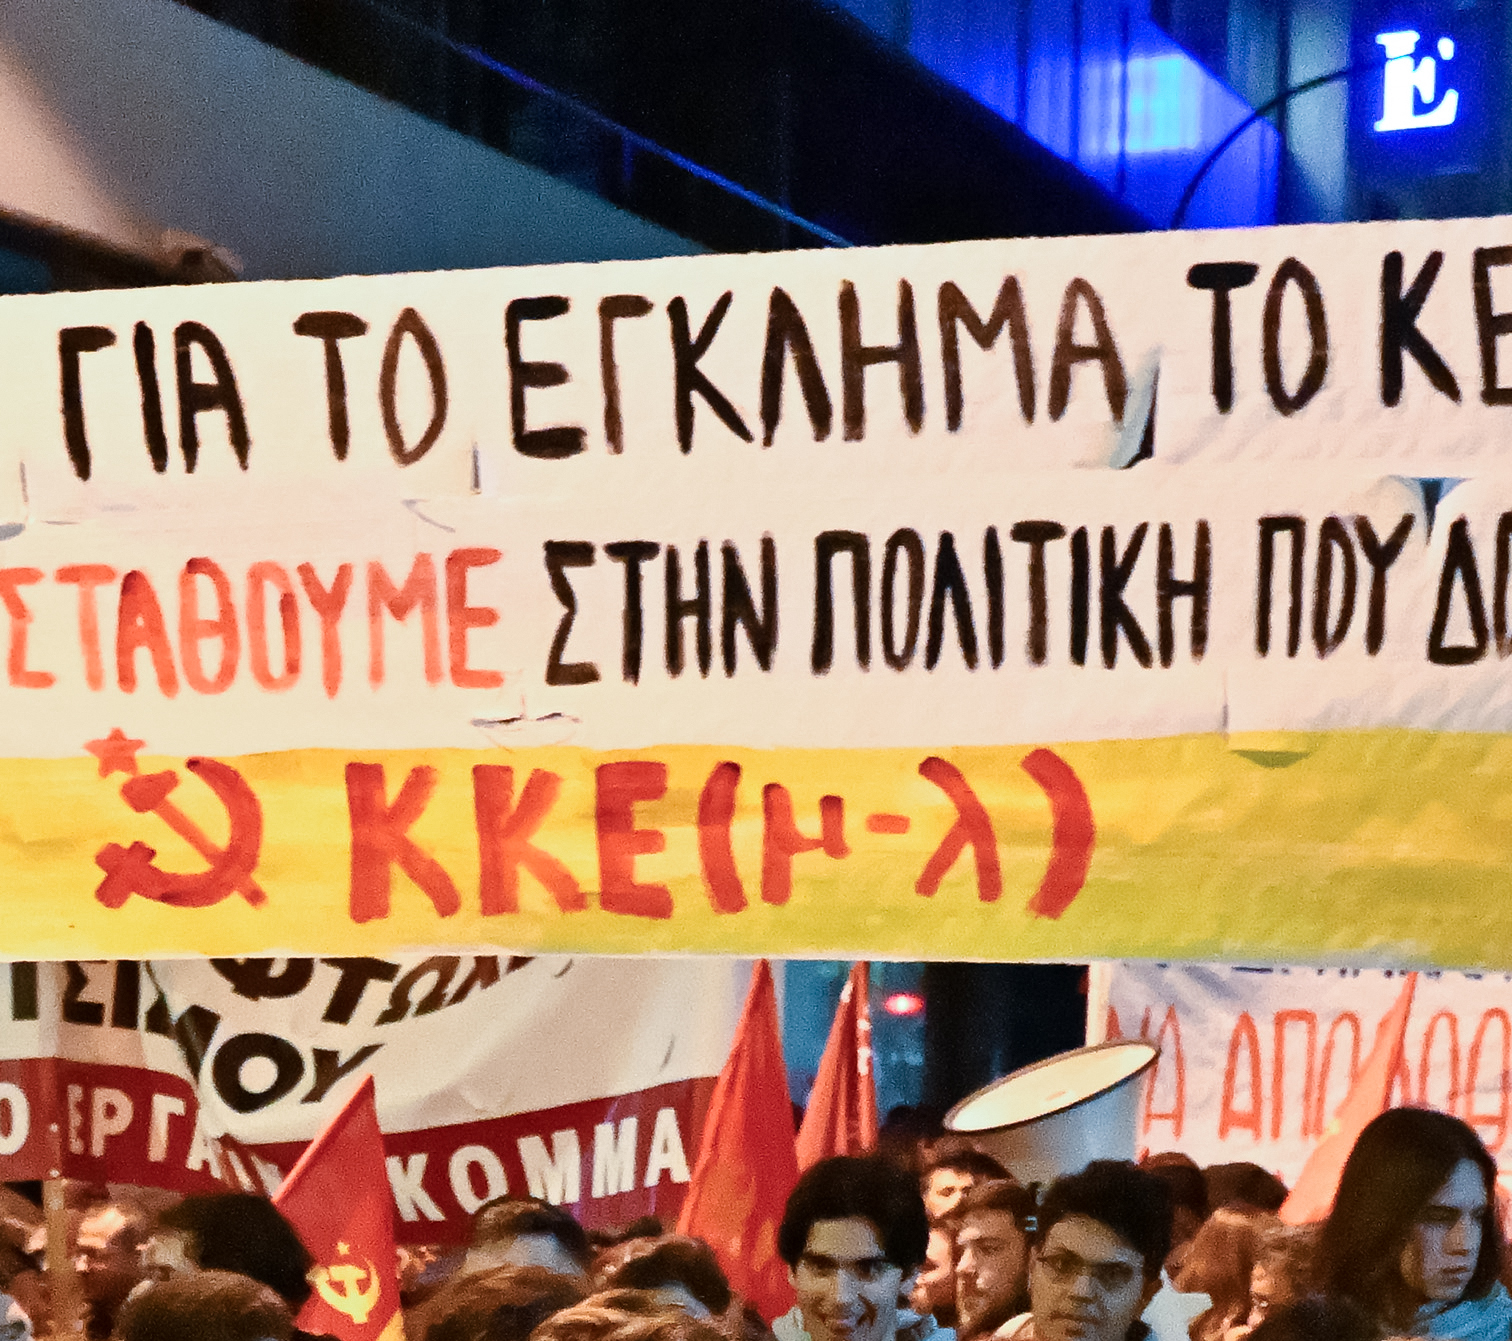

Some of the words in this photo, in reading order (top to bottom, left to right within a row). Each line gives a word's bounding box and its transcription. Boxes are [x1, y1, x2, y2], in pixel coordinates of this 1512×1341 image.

[59, 319, 253, 480] ΓΙΑ
[293, 306, 449, 467] ΤΟ
[504, 275, 1128, 458] ΕΓΚΛΗΜΑ
[1187, 255, 1331, 417] ΤΟ
[542, 530, 778, 686] ΣΤΗΝ
[811, 519, 1212, 677] ΠΟΛΙΤΙΚΗ
[1255, 511, 1415, 660] ΠΟΥ
[386, 1107, 692, 1223] ΚΟΜΜΑ
